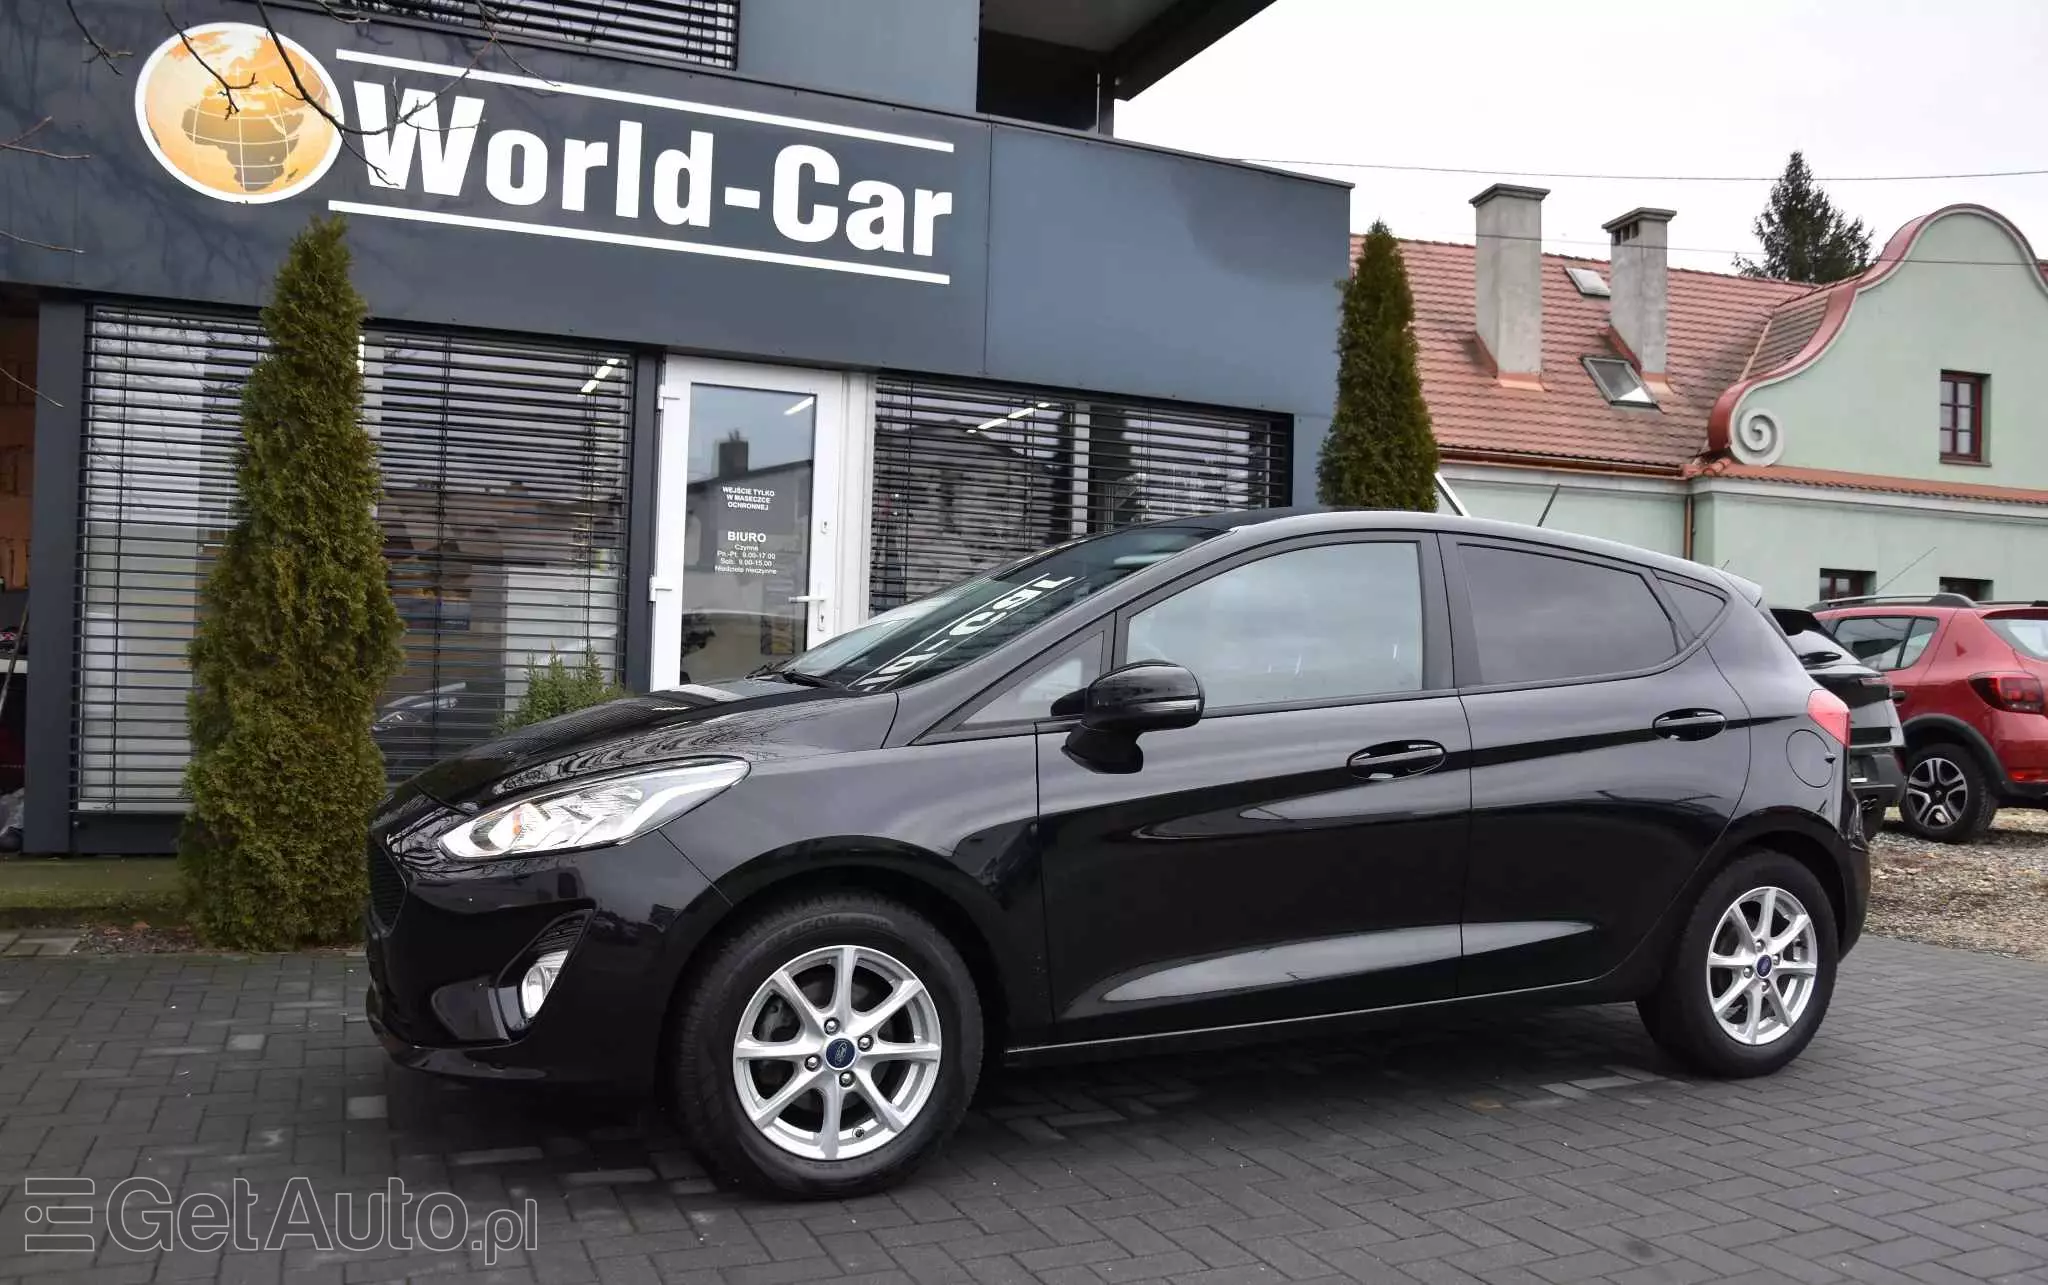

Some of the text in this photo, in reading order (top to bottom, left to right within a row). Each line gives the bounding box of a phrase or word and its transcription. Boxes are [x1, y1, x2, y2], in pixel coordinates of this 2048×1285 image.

[353, 79, 953, 257] World-Car
[753, 488, 775, 497] TYLKO
[727, 501, 769, 511] OCHRONNEJ
[727, 531, 767, 543] BIURO
